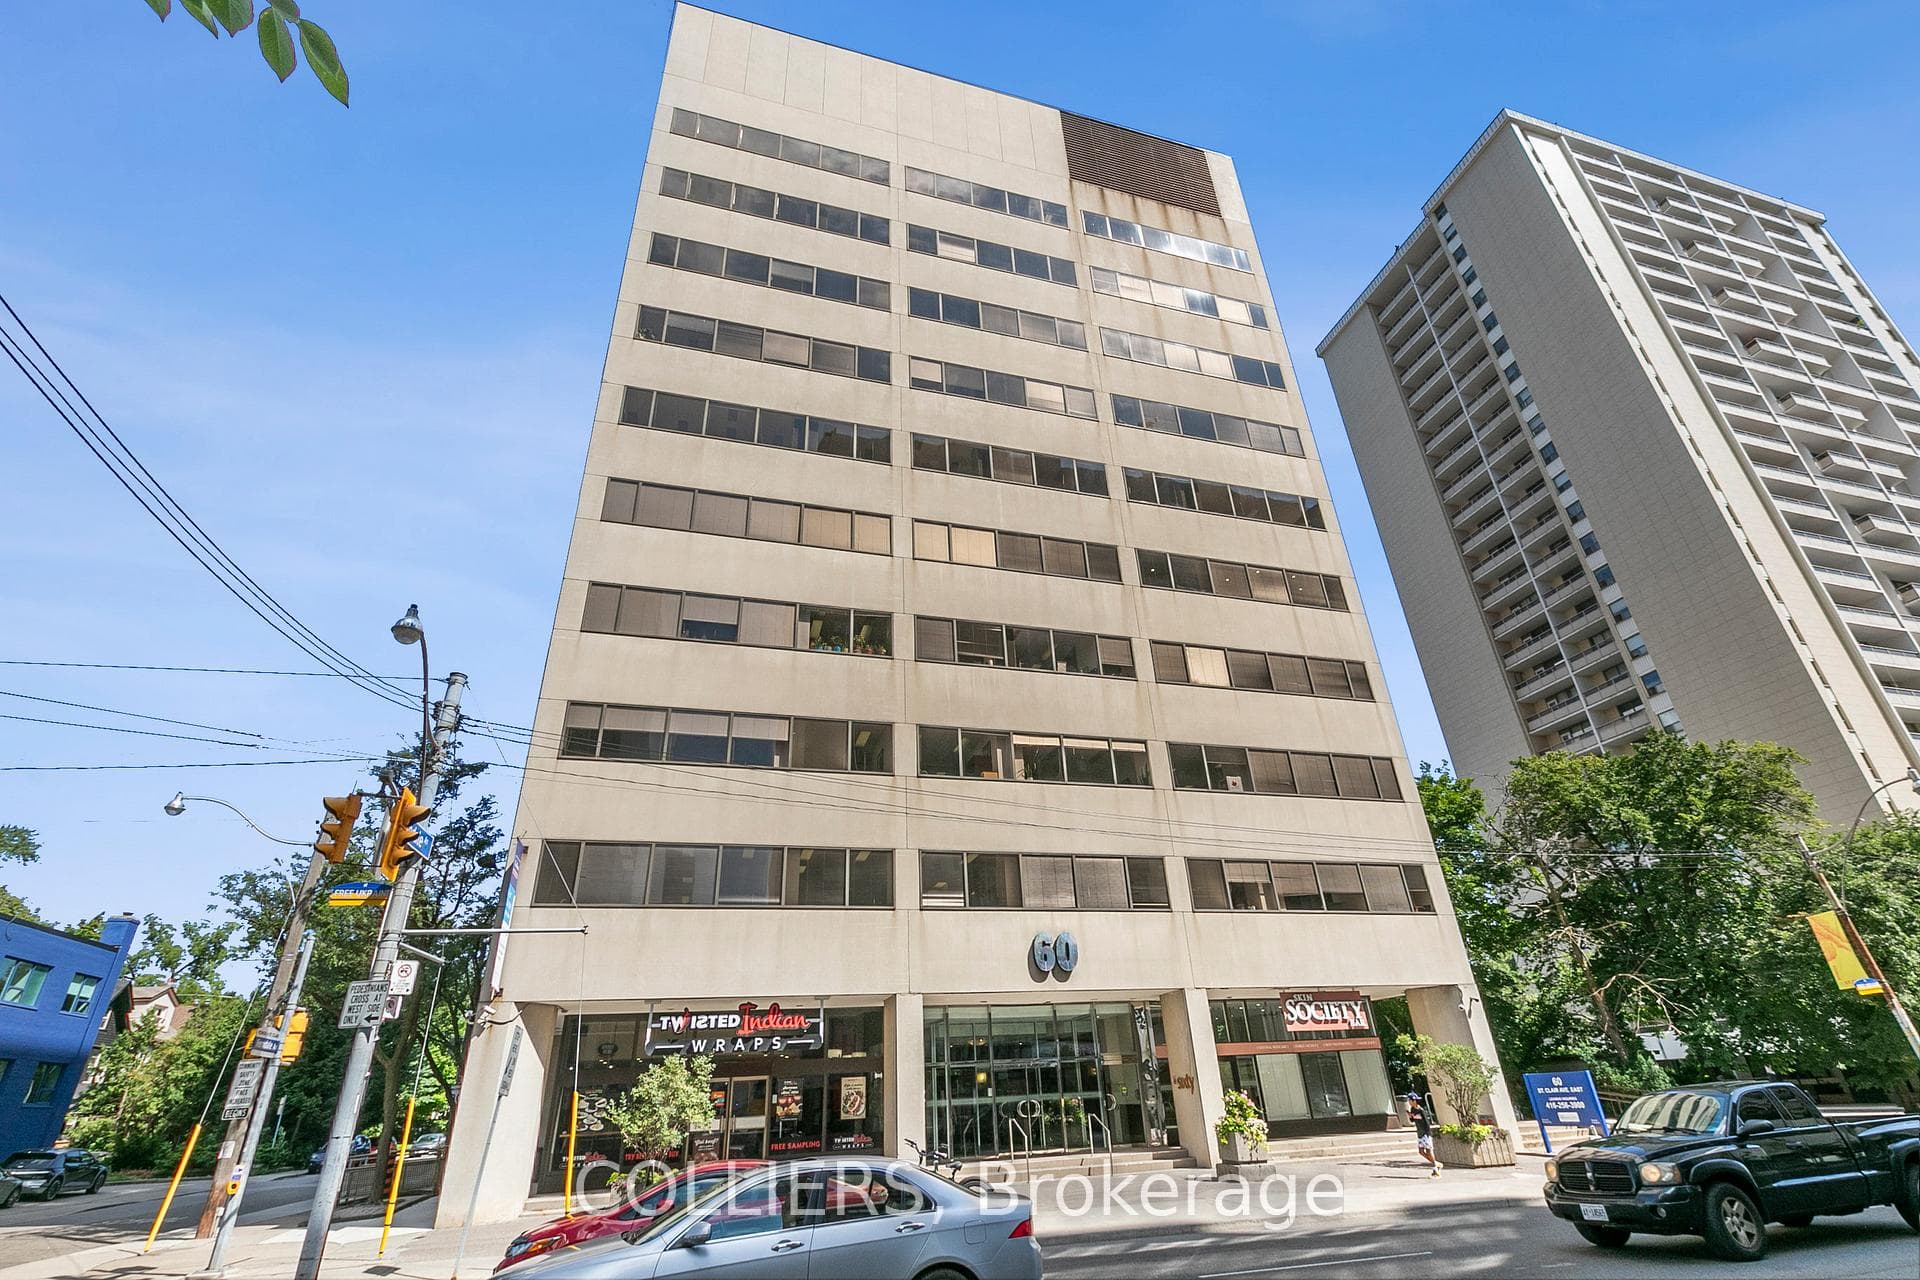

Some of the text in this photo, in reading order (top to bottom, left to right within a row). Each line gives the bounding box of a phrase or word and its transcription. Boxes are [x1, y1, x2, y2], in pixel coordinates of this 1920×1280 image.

[1033, 931, 1078, 972] 60
[351, 983, 389, 994] PEDESTRIANS
[350, 993, 382, 1004] CROSS AT
[1293, 993, 1314, 1002] SKIN
[347, 1004, 381, 1014] WEST SIDE
[1285, 999, 1363, 1022] SOCIETY
[343, 1015, 360, 1025] ONLY
[735, 1002, 810, 1036] Indian
[692, 1036, 782, 1053] WRAPS
[1551, 1076, 1563, 1087] 60
[770, 1140, 820, 1151] FREE SAMPLING
